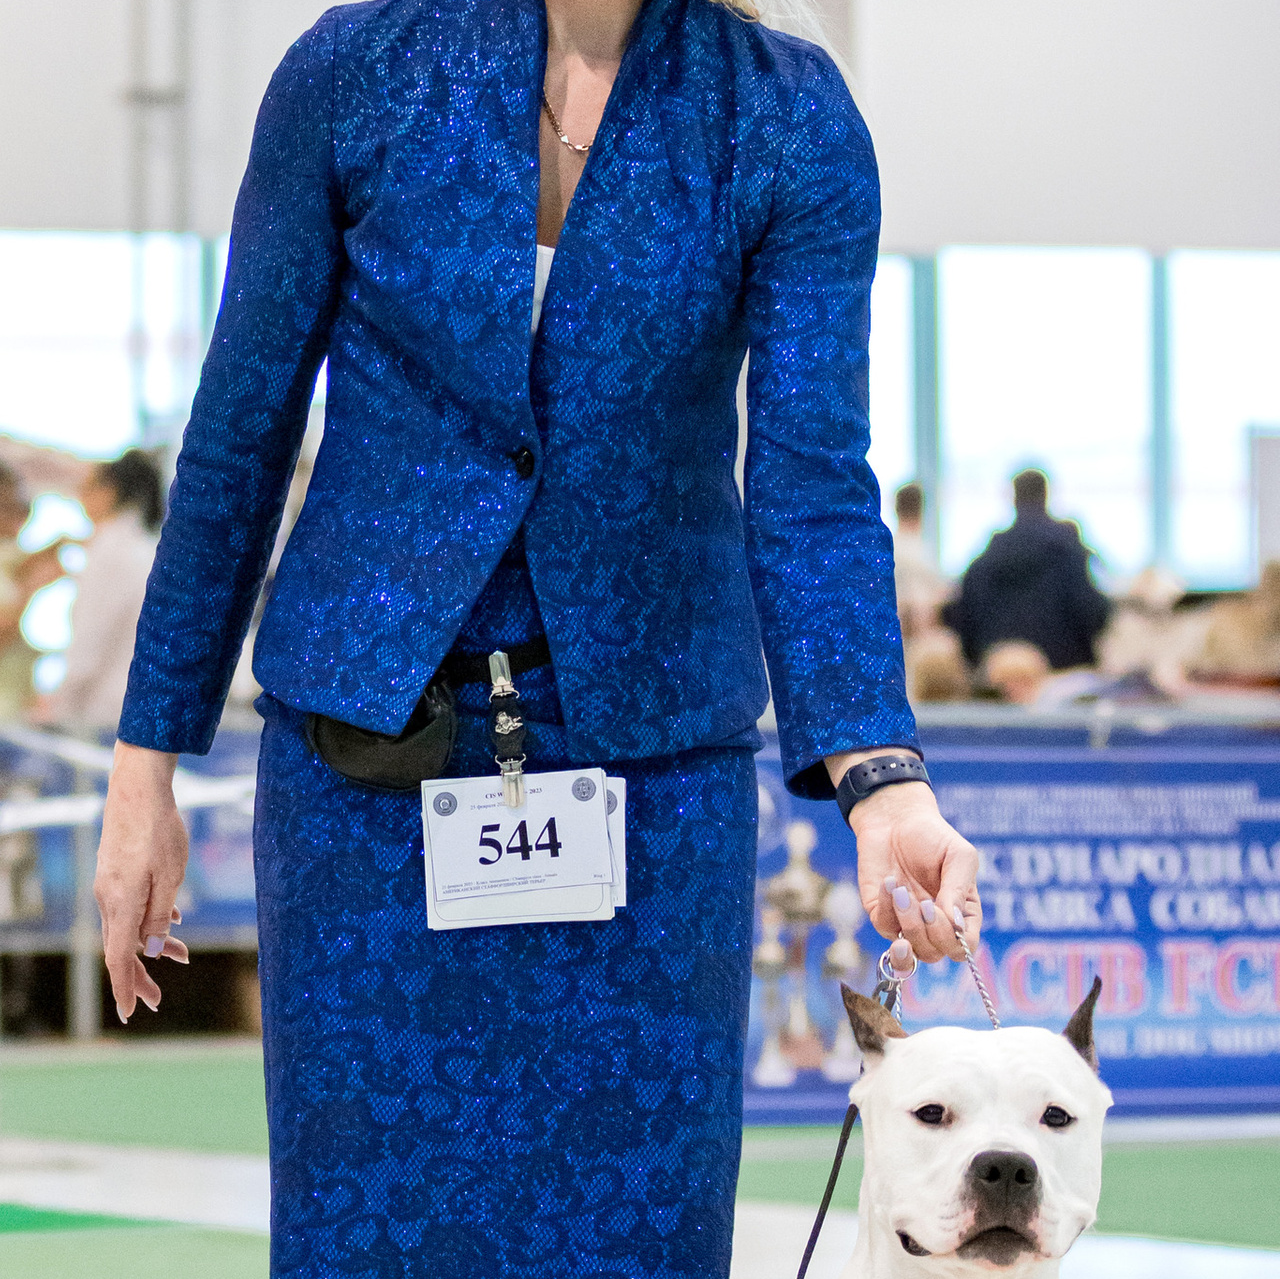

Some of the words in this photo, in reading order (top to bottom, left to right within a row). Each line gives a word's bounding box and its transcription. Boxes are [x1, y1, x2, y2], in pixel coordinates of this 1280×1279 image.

[478, 817, 562, 865] 544
[1148, 888, 1280, 931] СОБА
[1159, 938, 1280, 1015] FC
